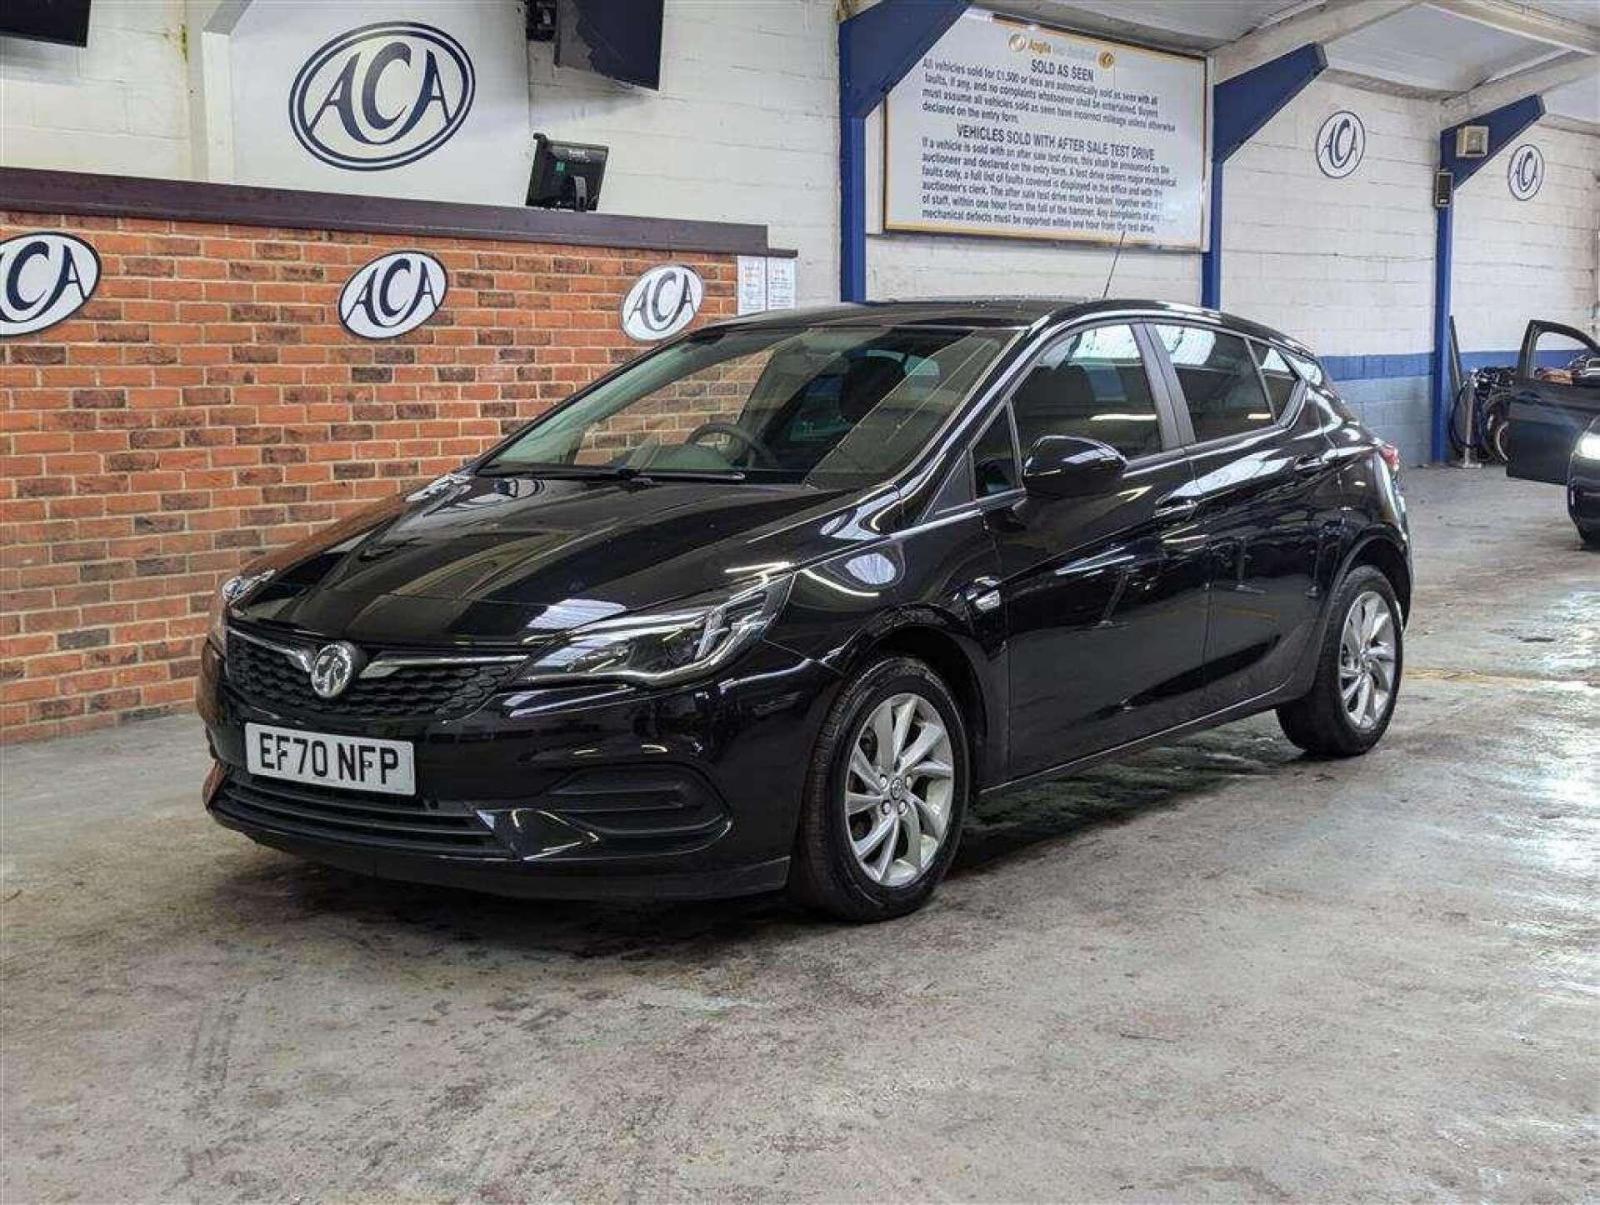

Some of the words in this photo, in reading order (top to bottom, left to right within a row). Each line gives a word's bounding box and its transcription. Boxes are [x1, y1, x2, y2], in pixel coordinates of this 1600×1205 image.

[935, 60, 965, 74] vehicles
[967, 66, 982, 77] sold
[985, 68, 995, 78] for
[1031, 59, 1055, 75] SOLD
[1057, 64, 1068, 78] AS
[1071, 65, 1094, 81] SEEN
[307, 41, 451, 145] ACA
[922, 88, 941, 98] must
[944, 91, 971, 103] assume
[974, 95, 982, 104] all
[985, 96, 1013, 109] vehicles
[1015, 101, 1029, 111] sold
[974, 81, 987, 92] and
[989, 84, 998, 93] no
[1000, 85, 1036, 99] complaints
[922, 101, 955, 115] declared
[957, 107, 966, 116] on
[968, 106, 979, 118] the
[981, 110, 1000, 122] entry
[936, 140, 962, 151] vehicle
[972, 143, 988, 154] sold
[990, 145, 1005, 156] with
[957, 123, 1004, 143] VEHICLES
[1007, 130, 1031, 145] SOLD
[1033, 133, 1055, 148] WITH
[1057, 137, 1084, 151] AFTER
[1087, 140, 1108, 155] SALE
[1110, 143, 1130, 157] TEST
[1132, 146, 1155, 161] DRIVE
[1320, 118, 1357, 169] ACA
[922, 153, 961, 165] auctioneer
[963, 157, 976, 167] and
[978, 157, 1009, 170] declared
[1010, 162, 1019, 171] on
[1021, 162, 1031, 172] the
[922, 165, 942, 177] faults
[970, 170, 982, 181] full
[983, 171, 994, 181] list
[995, 173, 1004, 183] of
[990, 185, 1003, 196] The
[922, 194, 930, 204] of
[952, 198, 975, 207] within
[990, 199, 1007, 210] hour
[922, 209, 964, 220] mechanical
[966, 211, 992, 222] defects
[993, 213, 1011, 223] must
[1012, 214, 1021, 224] be
[0, 241, 86, 324] CA
[343, 258, 438, 328] ACA
[628, 270, 697, 333] ACA
[259, 732, 328, 778] EF70
[337, 742, 399, 785] NFP
